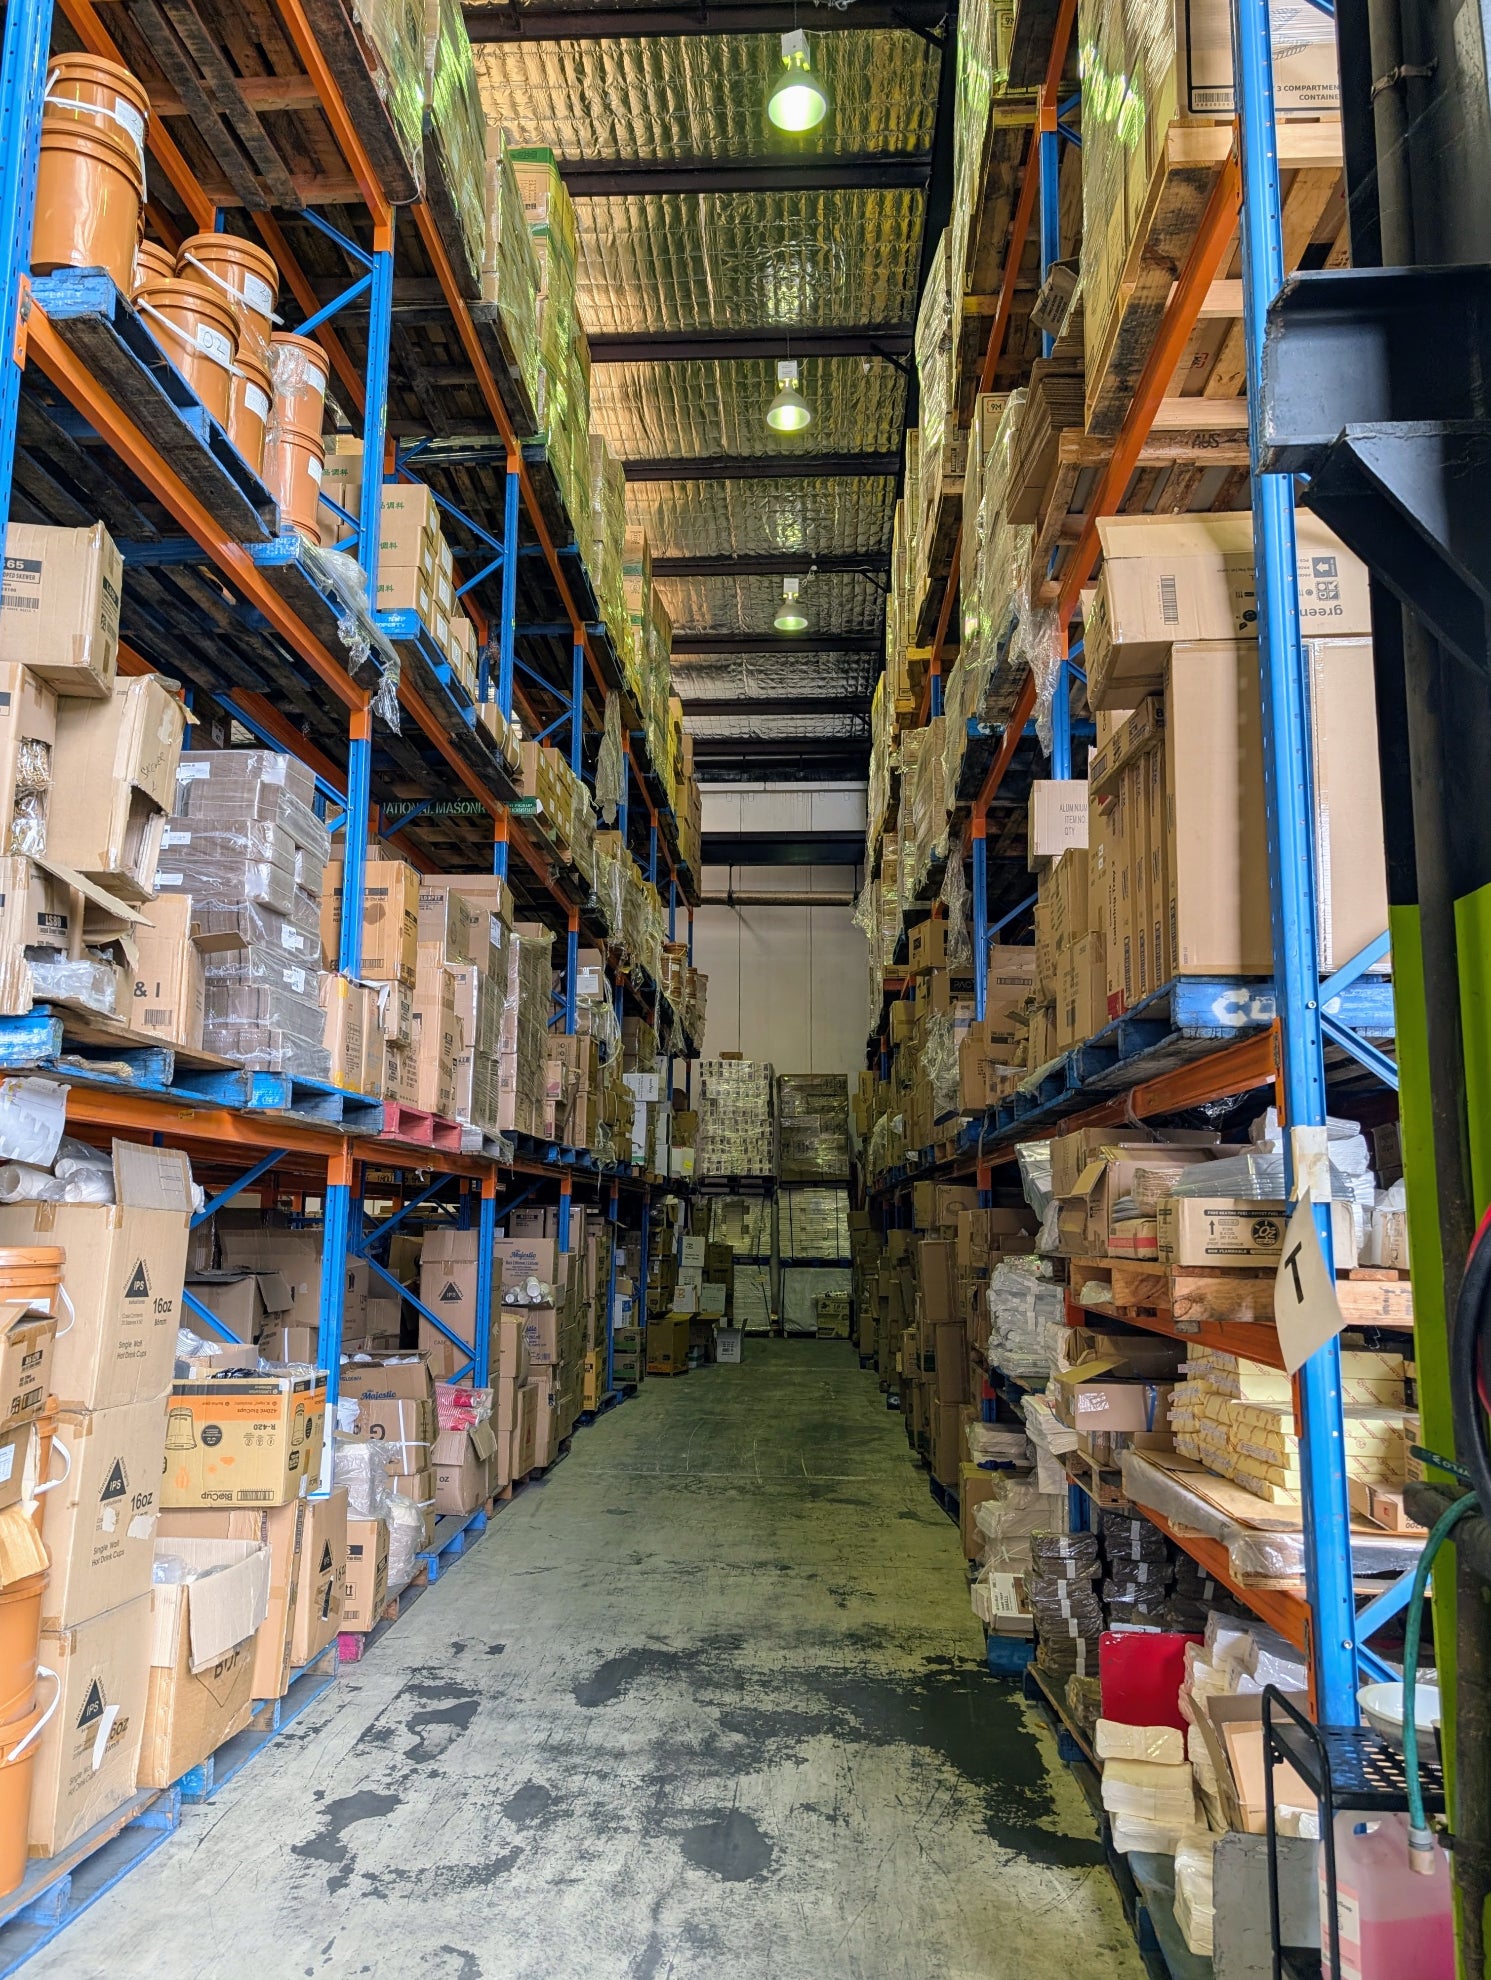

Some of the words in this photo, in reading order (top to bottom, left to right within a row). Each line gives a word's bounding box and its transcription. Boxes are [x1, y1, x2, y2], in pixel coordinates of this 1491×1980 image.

[1192, 433, 1220, 448] AUS
[1299, 605, 1343, 619] green
[1284, 1240, 1305, 1304] T
[133, 1280, 145, 1291] IPS
[153, 1297, 173, 1314] 16oz
[361, 1390, 397, 1400] Majestic
[253, 1423, 276, 1431] R-420
[109, 1479, 122, 1492] IPS
[131, 1492, 154, 1512] 16oz
[200, 1491, 233, 1502] BioCup
[93, 1544, 109, 1556] Single
[113, 1549, 125, 1559] Cups
[86, 1700, 100, 1717] IPS
[109, 1716, 130, 1740] 6oz
